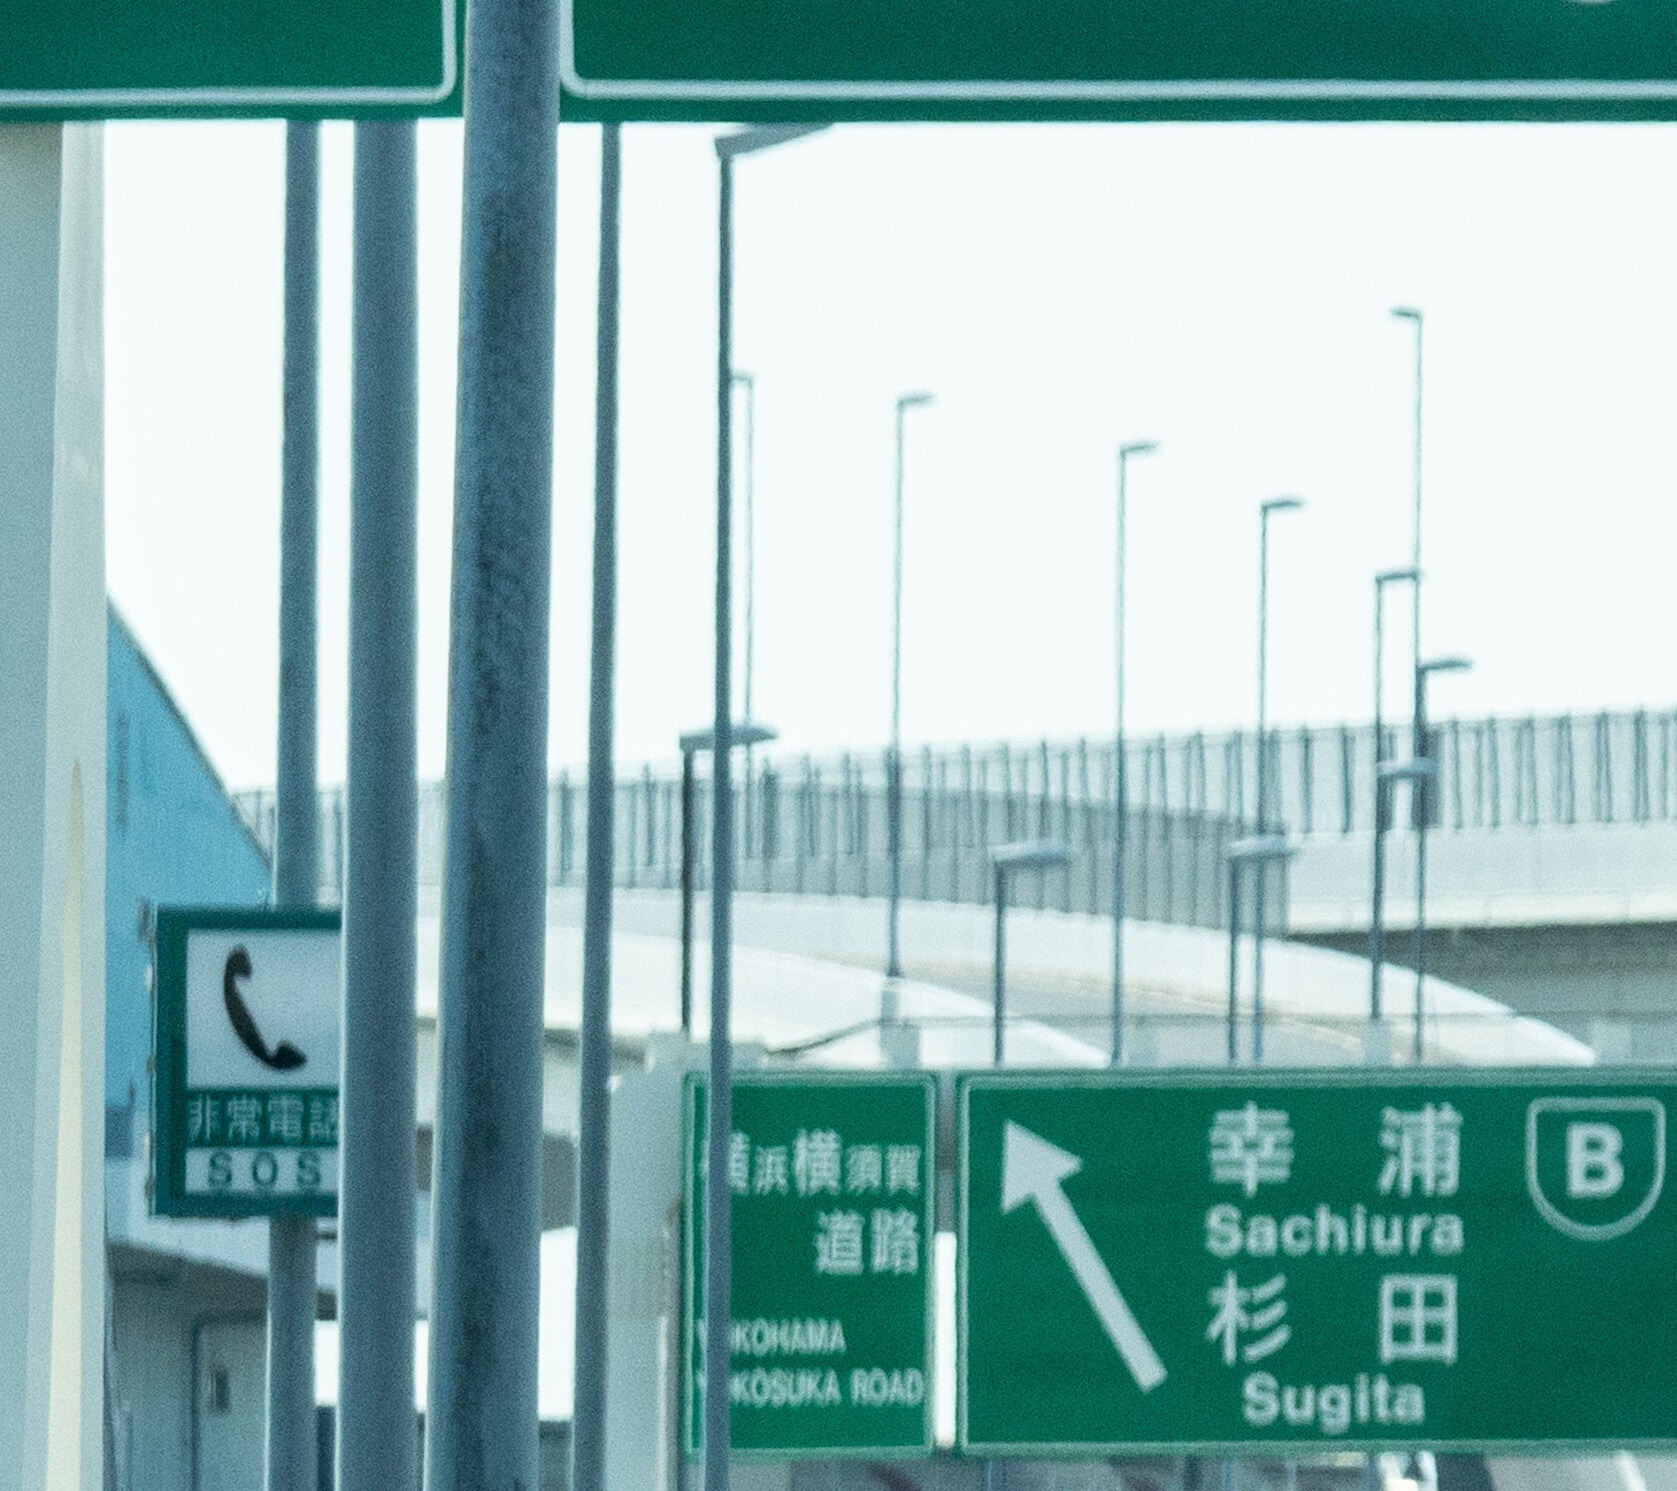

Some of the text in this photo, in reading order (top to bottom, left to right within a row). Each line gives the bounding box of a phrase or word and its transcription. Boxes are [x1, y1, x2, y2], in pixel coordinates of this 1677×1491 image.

[208, 1151, 321, 1188] SOS
[1210, 1103, 1461, 1195] 幸浦
[1567, 1124, 1623, 1197] B
[817, 1210, 918, 1273] 道路
[1206, 1205, 1463, 1256] Sachiura
[1208, 1272, 1457, 1364] 杉田
[851, 1368, 924, 1406] ROAD
[1243, 1372, 1424, 1433] Sugita
